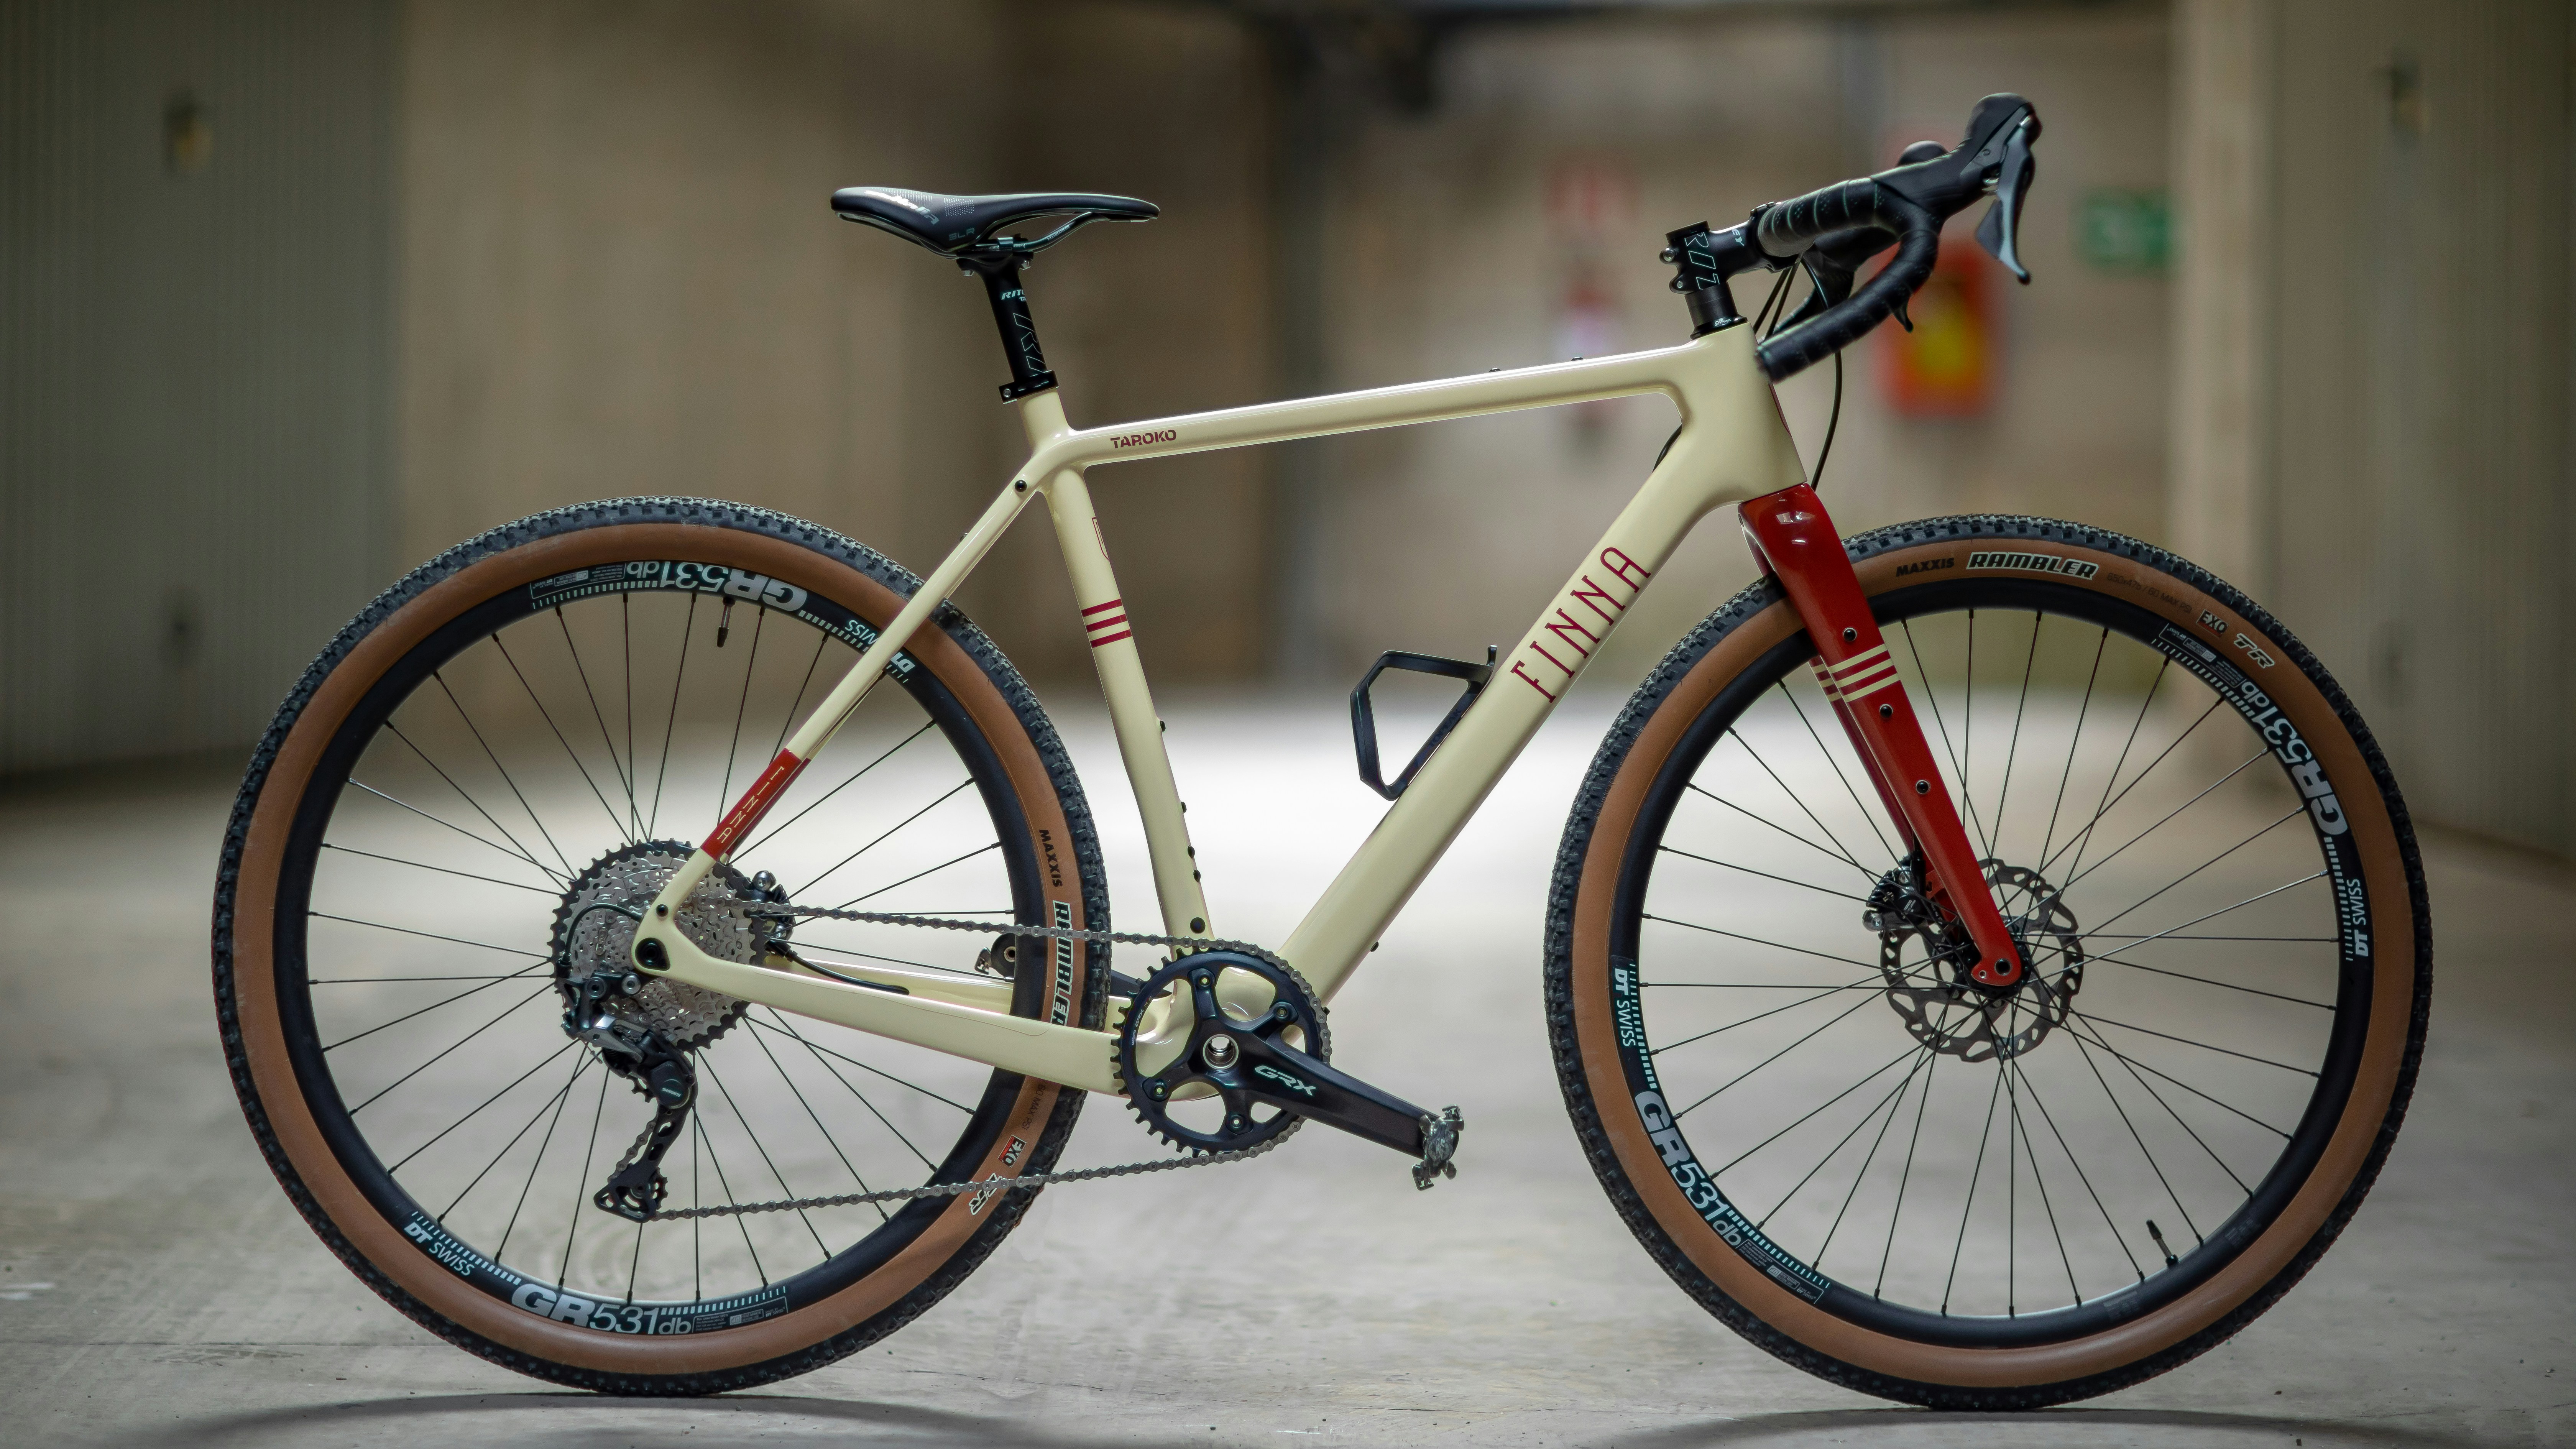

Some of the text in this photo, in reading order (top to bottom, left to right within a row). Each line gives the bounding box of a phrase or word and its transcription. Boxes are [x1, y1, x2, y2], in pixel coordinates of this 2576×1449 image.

[949, 228, 975, 241] SLR
[1111, 429, 1176, 449] TAROKO
[1896, 557, 1955, 577] MAXXIS
[1966, 551, 2100, 581] RAMBLER
[2159, 592, 2181, 607] MAX
[2180, 601, 2193, 614] PSI
[1510, 547, 1651, 703] FINNA
[2200, 610, 2229, 634] EXO
[844, 620, 915, 673] DT WISS
[2233, 633, 2275, 668] TR
[717, 766, 785, 844] FINNA
[1039, 830, 1063, 887] MAXXIS
[2347, 879, 2368, 957] DT SWISS
[1135, 1009, 1144, 1027] GRX
[1615, 968, 1636, 1047] DT SWISS
[1035, 1084, 1045, 1096] 60
[1255, 1065, 1316, 1096] GRX
[1028, 1096, 1045, 1116] MAX
[1021, 1118, 1033, 1130] PSI
[1002, 1137, 1026, 1166] EXO
[404, 1222, 475, 1276] DT SWISS
